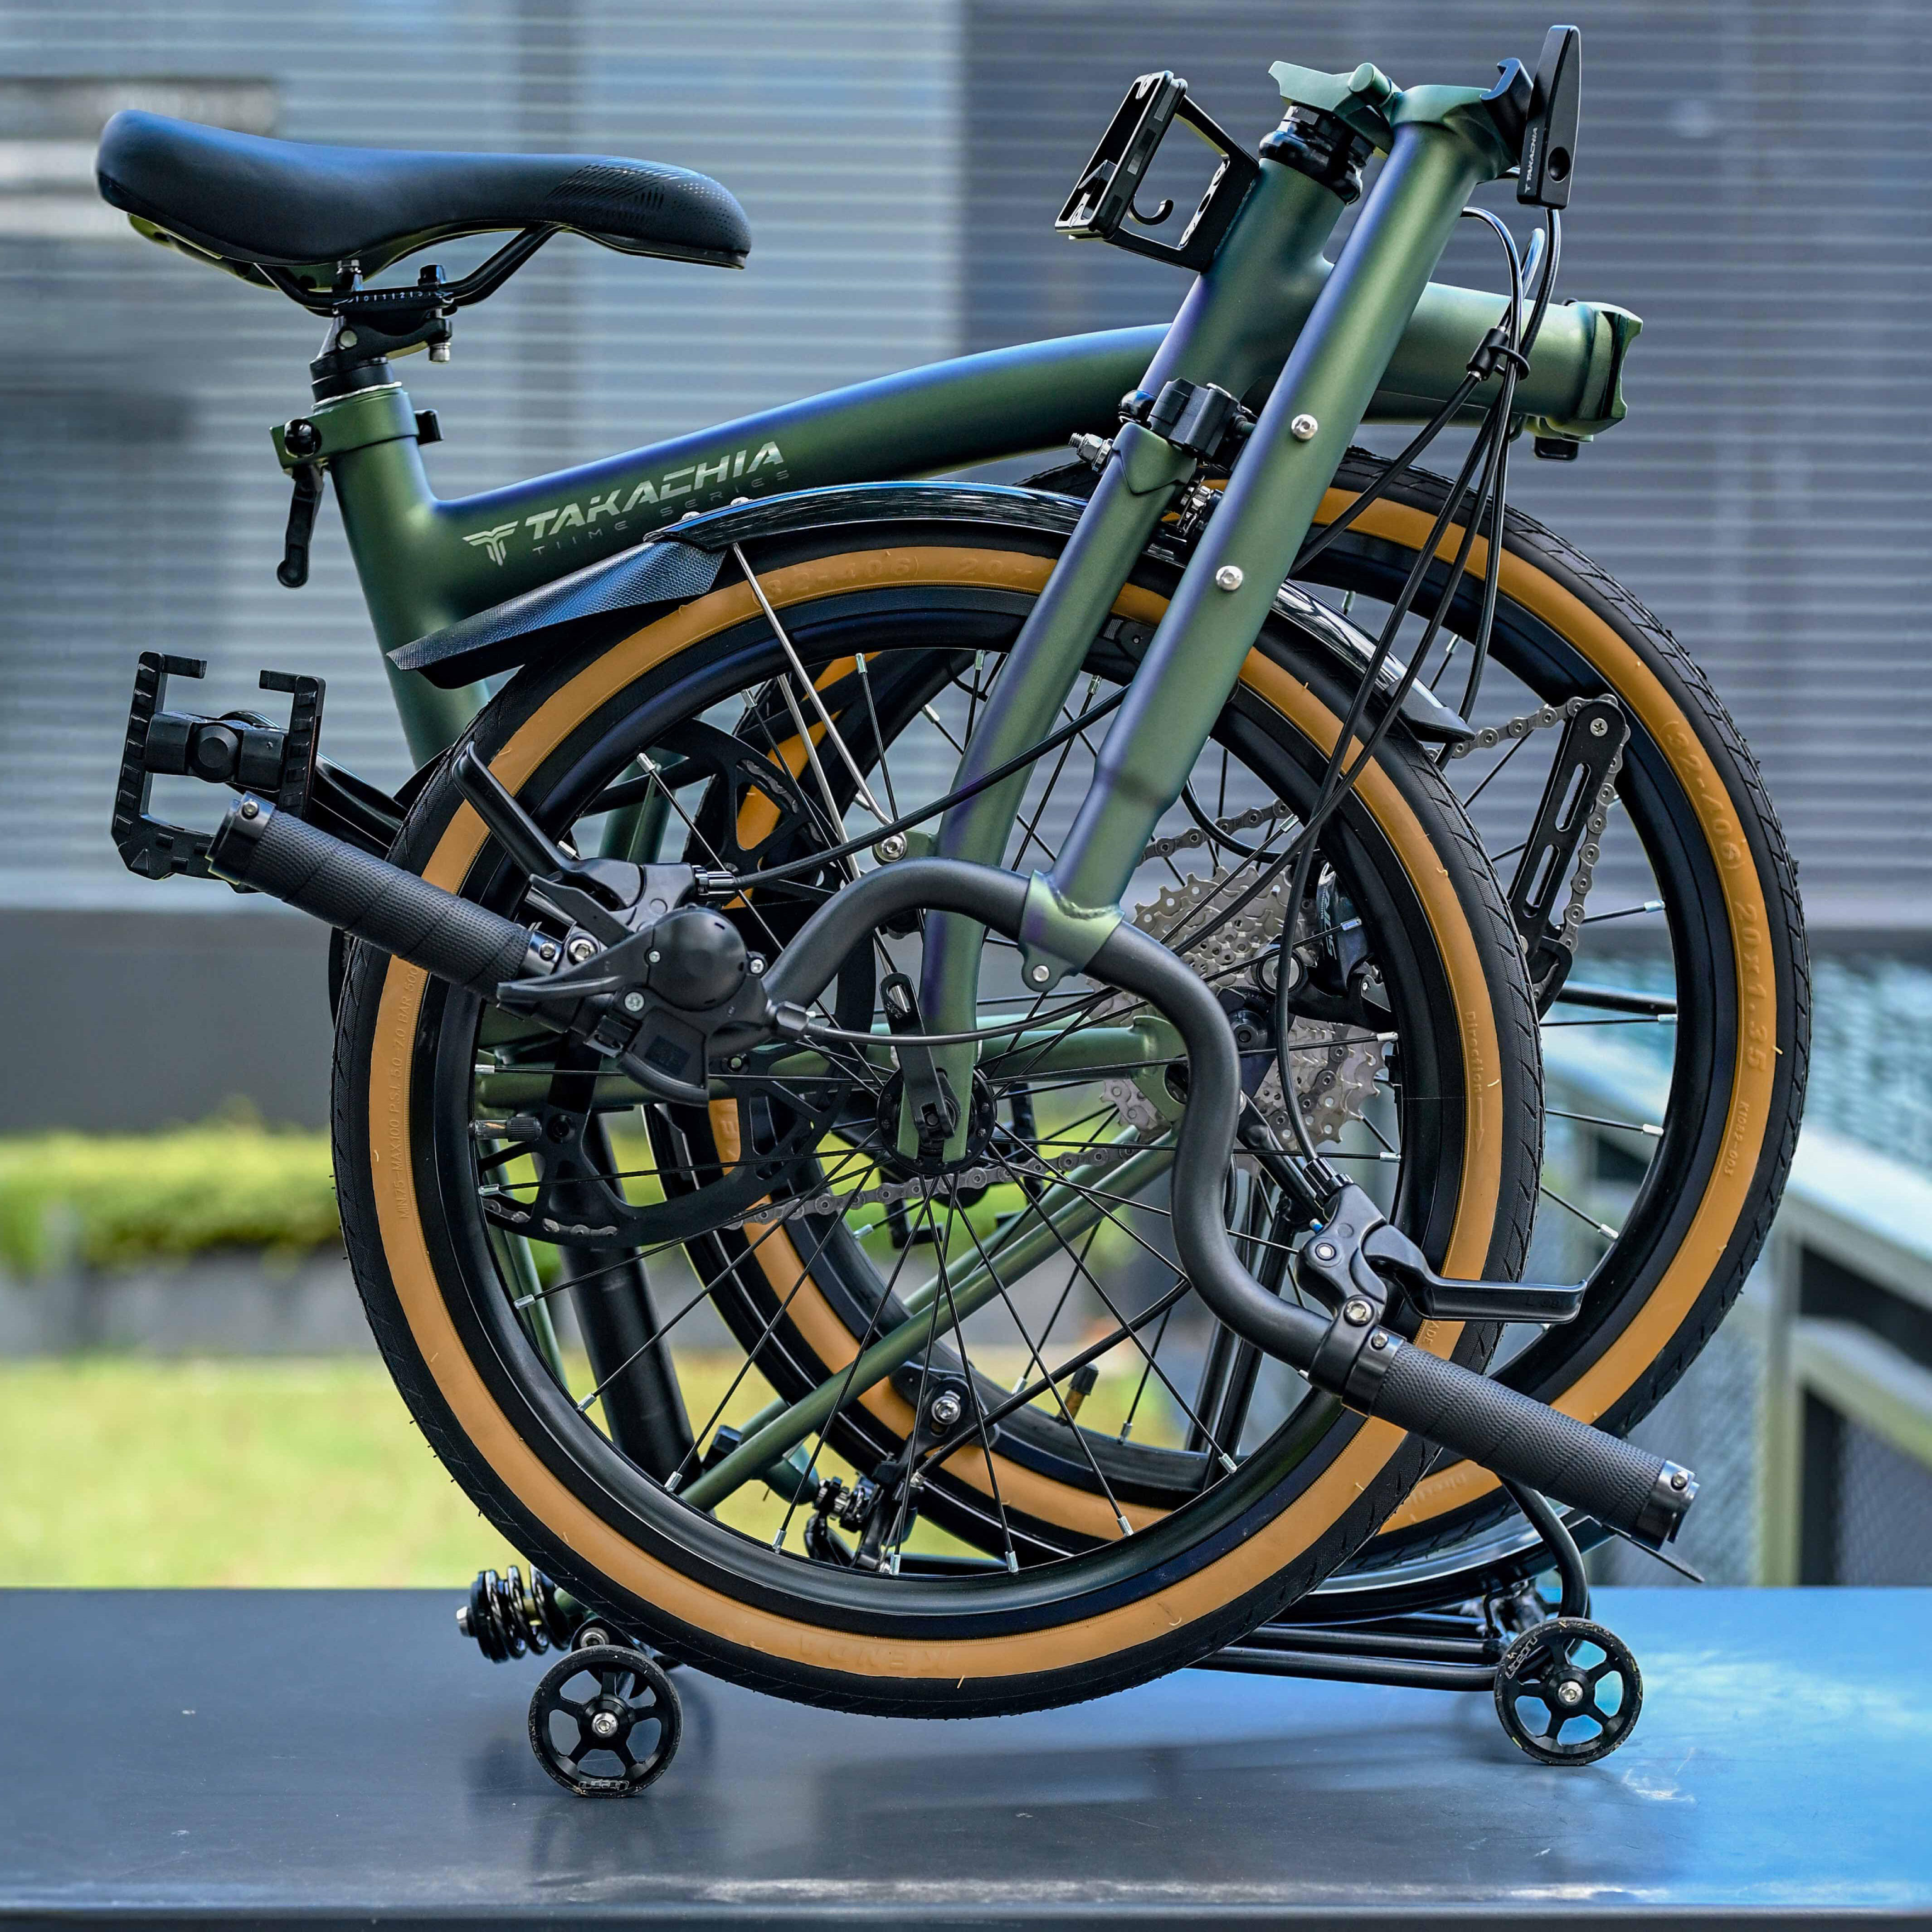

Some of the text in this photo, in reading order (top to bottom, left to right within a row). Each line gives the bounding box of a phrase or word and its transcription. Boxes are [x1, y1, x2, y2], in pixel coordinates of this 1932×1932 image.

[524, 441, 784, 540] TAKACHIA
[660, 469, 790, 516] SERIES
[398, 995, 412, 1023] BAR
[1423, 1320, 1440, 1345] ADE
